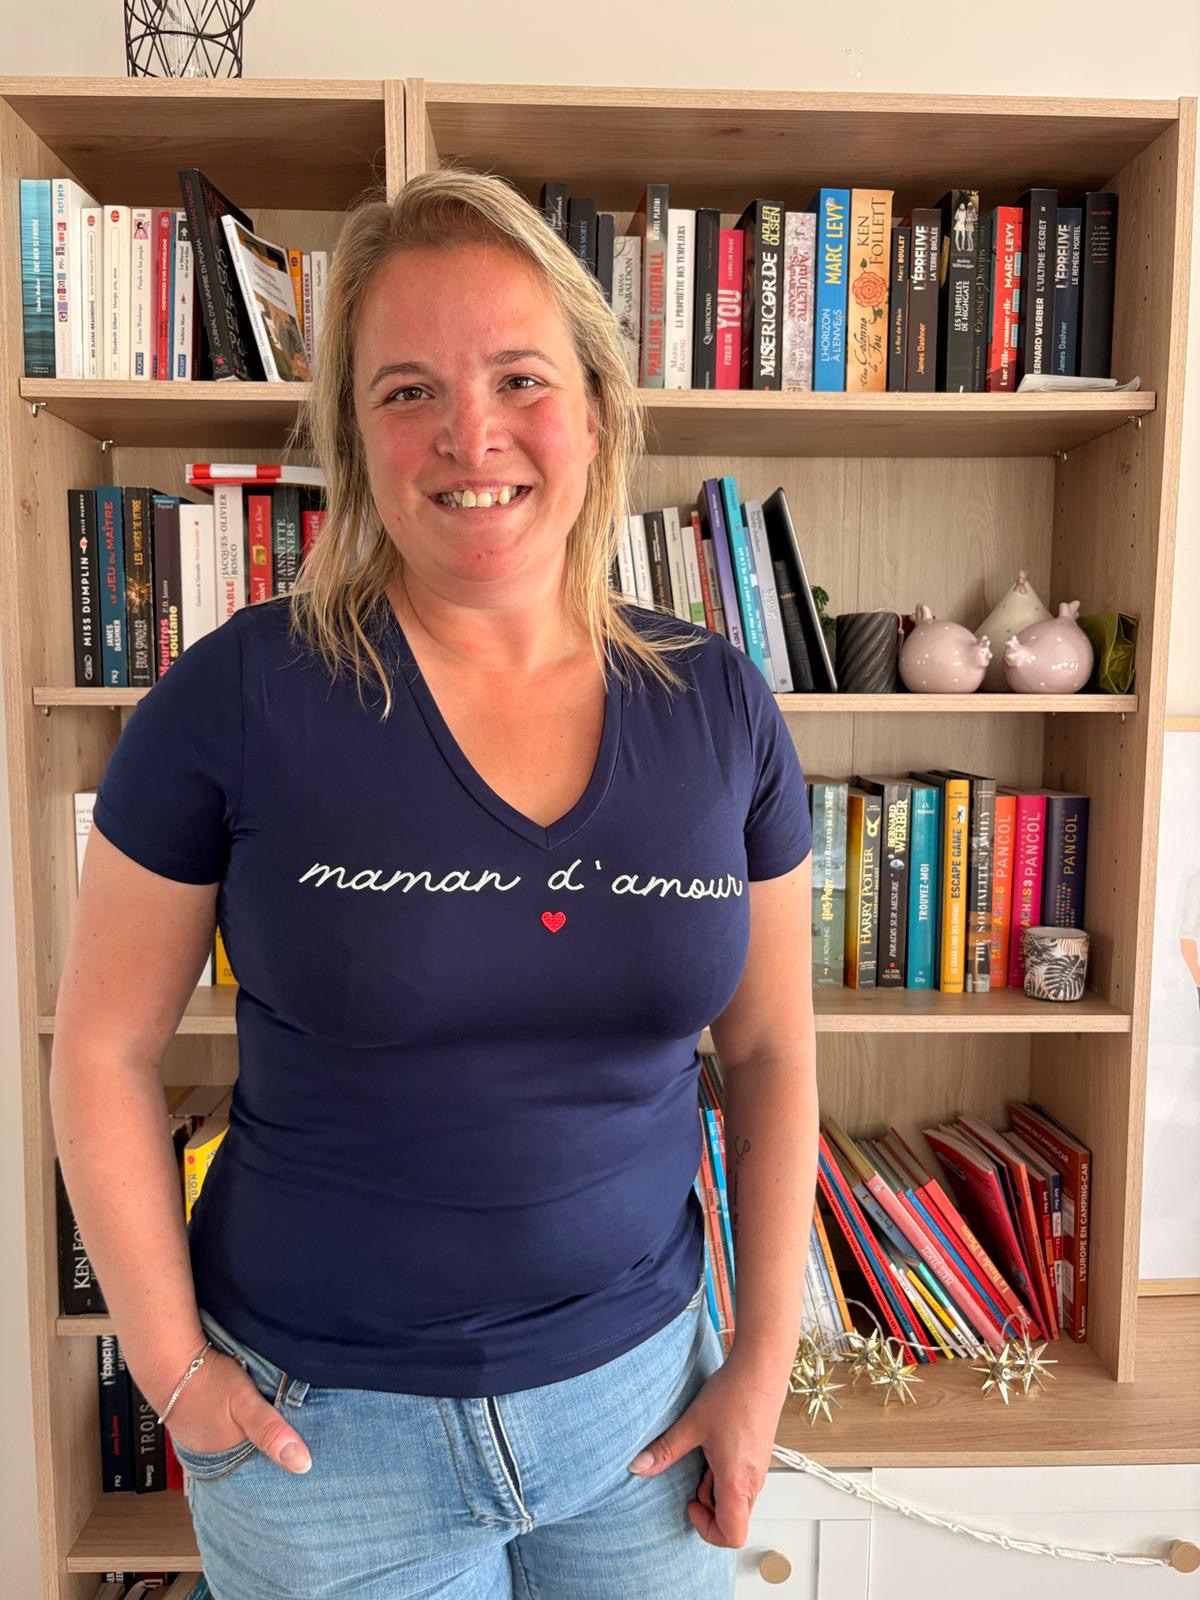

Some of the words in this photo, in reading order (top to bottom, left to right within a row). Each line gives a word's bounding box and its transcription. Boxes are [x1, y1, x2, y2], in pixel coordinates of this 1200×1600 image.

[652, 197, 661, 219] PLATINI
[761, 205, 771, 241] ADLER
[826, 199, 844, 238] LEVY
[651, 220, 661, 241] MICHEL
[770, 207, 780, 246] OLSEN
[857, 215, 869, 247] KEN
[869, 197, 886, 265] FOLLETT
[929, 226, 939, 251] BRÛLÉE
[1005, 222, 1015, 252] LEVY
[1037, 219, 1048, 251] SECRET
[1072, 224, 1081, 250] MORTEL
[675, 225, 686, 264] TEMPLIERS
[897, 234, 905, 263] BOULET
[911, 225, 929, 291] L'ÉPREUVE
[1055, 223, 1072, 289] L'ÉPREUVE
[675, 265, 685, 278] DES
[824, 243, 843, 285] MARC
[897, 263, 905, 282] Marc
[930, 272, 937, 281] LA
[1003, 254, 1013, 289] MARC
[1036, 251, 1046, 292] L'ULTIME
[1070, 251, 1080, 275] REMÈDE
[201, 273, 213, 300] VAMPIRE
[623, 257, 633, 313] GABALDON
[649, 251, 664, 315] FOOTBALL
[1071, 276, 1079, 285] LE
[671, 279, 685, 317] PROPHÉTIE
[716, 288, 741, 330] YOU
[759, 252, 778, 377] MISERICORDE
[954, 280, 962, 317] JUMELLES
[961, 279, 970, 320] HIGHGATE
[1002, 297, 1011, 315] elle
[209, 317, 221, 348] JOURNAL
[674, 319, 684, 328] LA
[832, 308, 842, 352] L'ENVERS
[895, 308, 903, 326] Pékin
[895, 327, 902, 335] de
[954, 318, 962, 331] LES
[961, 321, 969, 331] DE
[1003, 315, 1011, 348] comme
[1034, 297, 1045, 336] WERBER
[646, 319, 664, 376] PARLONS
[723, 332, 732, 343] ON
[821, 308, 830, 362] L'HORIZON
[895, 346, 902, 354] Le
[917, 322, 926, 352] Dashner
[1058, 321, 1068, 350] Dashner
[670, 342, 678, 368] MARIO
[678, 338, 686, 372] READING
[723, 344, 732, 366] FIXED
[831, 352, 841, 362] À
[916, 352, 925, 375] James
[1000, 348, 1009, 368] fille
[1033, 337, 1043, 375] ERNARD
[1057, 351, 1067, 373] James
[102, 501, 114, 550] MAÎTRE
[219, 493, 230, 576] JACQUES-OLIVIER
[133, 552, 144, 566] LES
[230, 543, 239, 576] BOSCO
[276, 518, 287, 577] ANNETTE
[285, 522, 295, 576] WIENERS
[80, 556, 91, 613] DUMPLIN
[107, 566, 117, 592] JEU
[111, 594, 117, 604] LE
[81, 617, 92, 647] MISS
[105, 623, 114, 647] JAMES
[113, 619, 122, 652] DASHNER
[134, 619, 148, 650] SPINDLER
[167, 605, 178, 658] soutane
[135, 650, 148, 669] ERICA
[887, 804, 897, 848] BERNARD
[895, 798, 908, 853] WERBER
[978, 810, 990, 856] FAMILY
[951, 828, 962, 857] GAME
[995, 814, 1011, 878] PANCOL
[1024, 812, 1040, 877] PANCOL
[1063, 813, 1077, 875] PANCOL
[298, 861, 522, 894] maman
[860, 846, 874, 897] POTTER
[950, 860, 961, 899] ESCAPE
[890, 880, 899, 910] MESURE
[918, 863, 930, 921] TROUVEZ-MOI
[975, 862, 988, 933] SOCIALITE
[859, 900, 873, 944] HARRY
[889, 910, 898, 927] SUR
[888, 927, 897, 958] PARADIS
[975, 938, 986, 962] THE
[1079, 1163, 1088, 1225] CAMPING-CAR
[960, 1224, 982, 1251] Picsou
[1079, 1226, 1087, 1239] EN
[73, 1256, 91, 1289] KEN
[981, 1257, 1003, 1281] Bande
[1078, 1241, 1087, 1282] L'EUROPE
[997, 1281, 1010, 1294] La
[139, 1403, 156, 1455] TROIS
